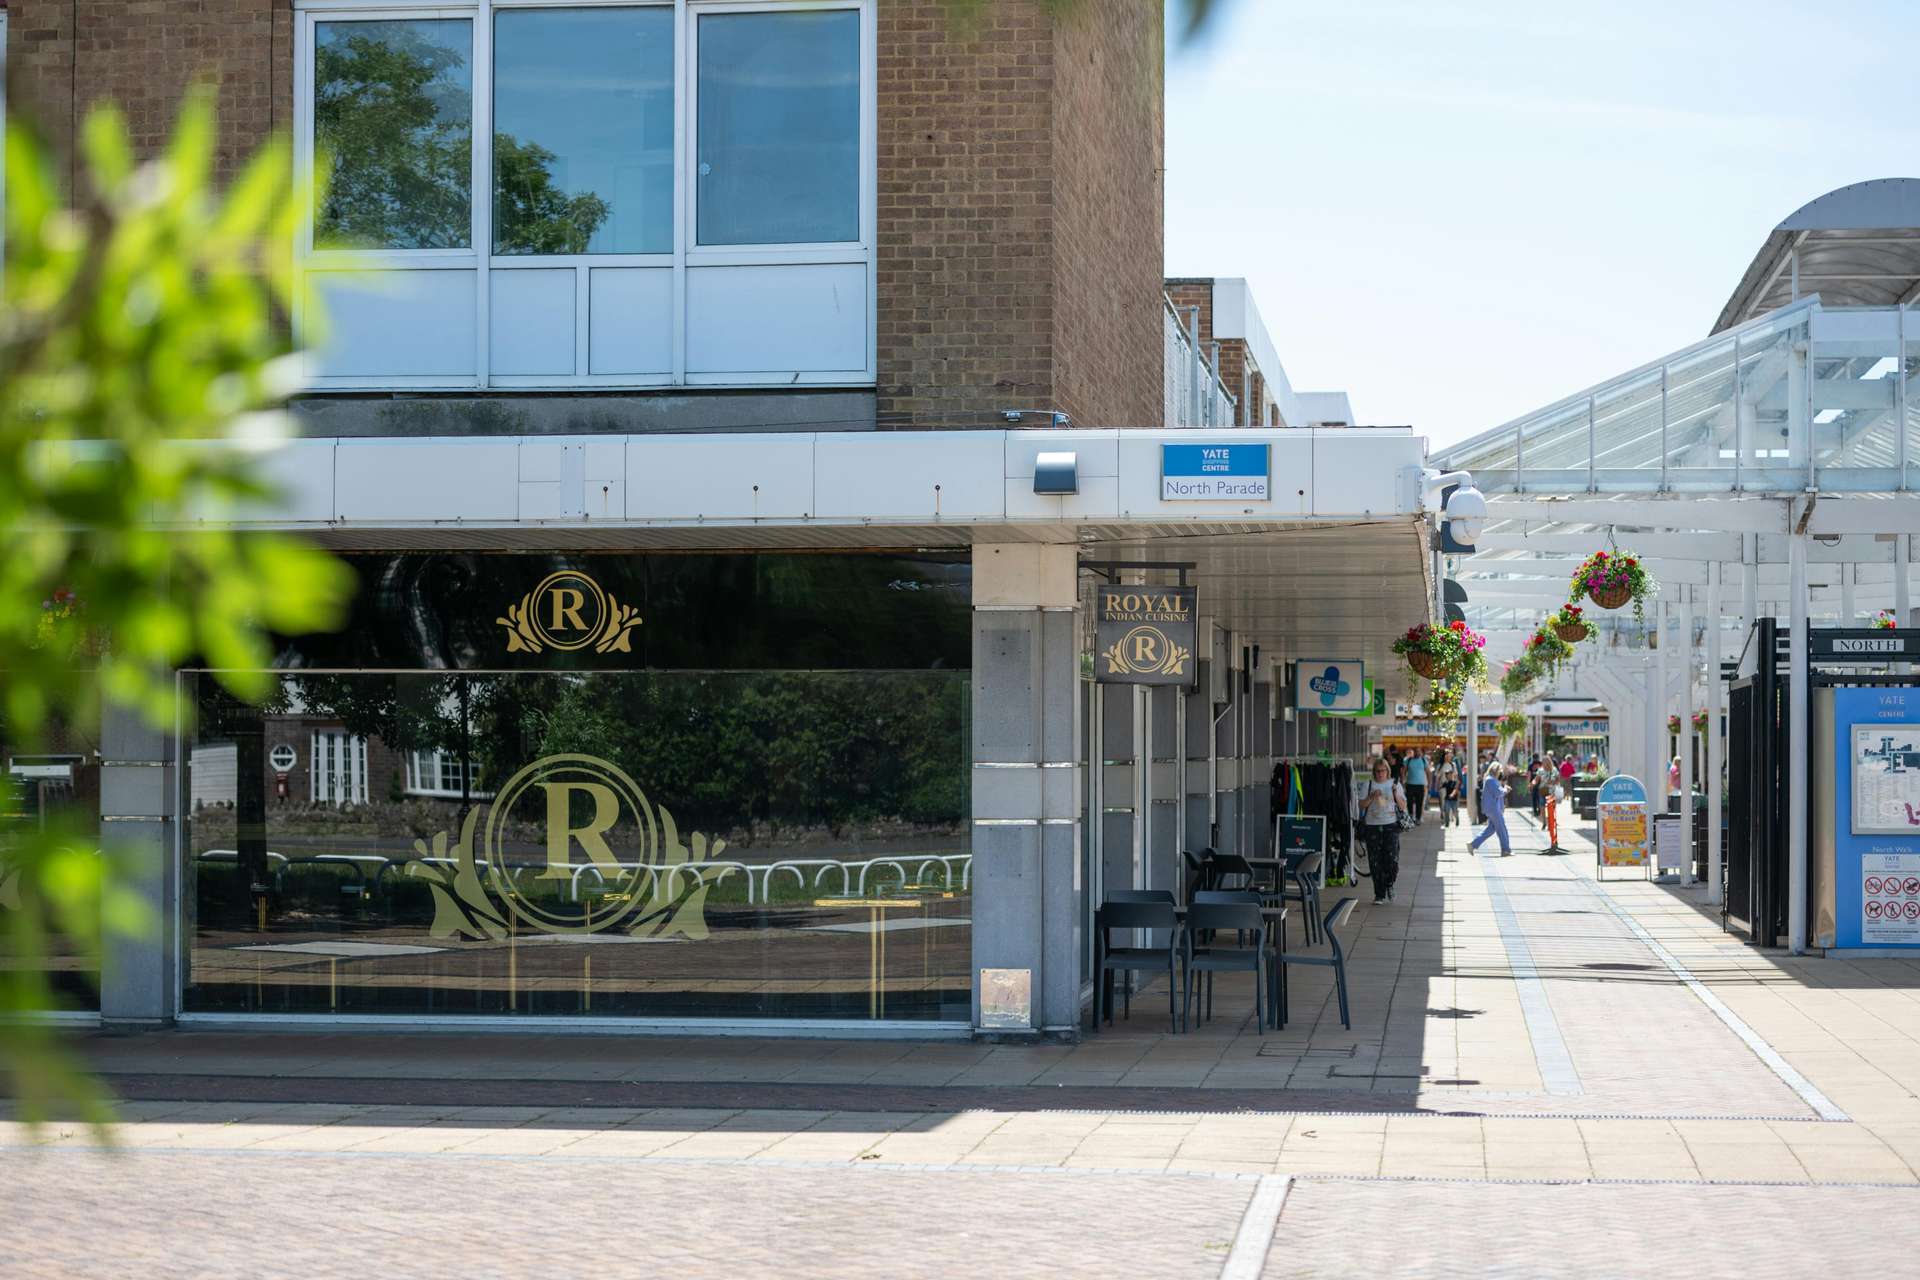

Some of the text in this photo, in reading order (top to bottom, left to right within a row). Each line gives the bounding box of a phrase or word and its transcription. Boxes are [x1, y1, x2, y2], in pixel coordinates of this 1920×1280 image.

[1202, 449, 1229, 458] YATE
[1166, 481, 1265, 495] North Parade
[1105, 594, 1189, 613] ROYAL
[547, 588, 590, 631] R
[1105, 612, 1188, 622] INDIAN CUISINE
[1134, 635, 1158, 662] R
[1840, 640, 1897, 651] NORTH
[1313, 684, 1337, 694] CROSS
[1879, 695, 1905, 705] YATE
[1613, 783, 1633, 791] YATE
[534, 781, 633, 881] R
